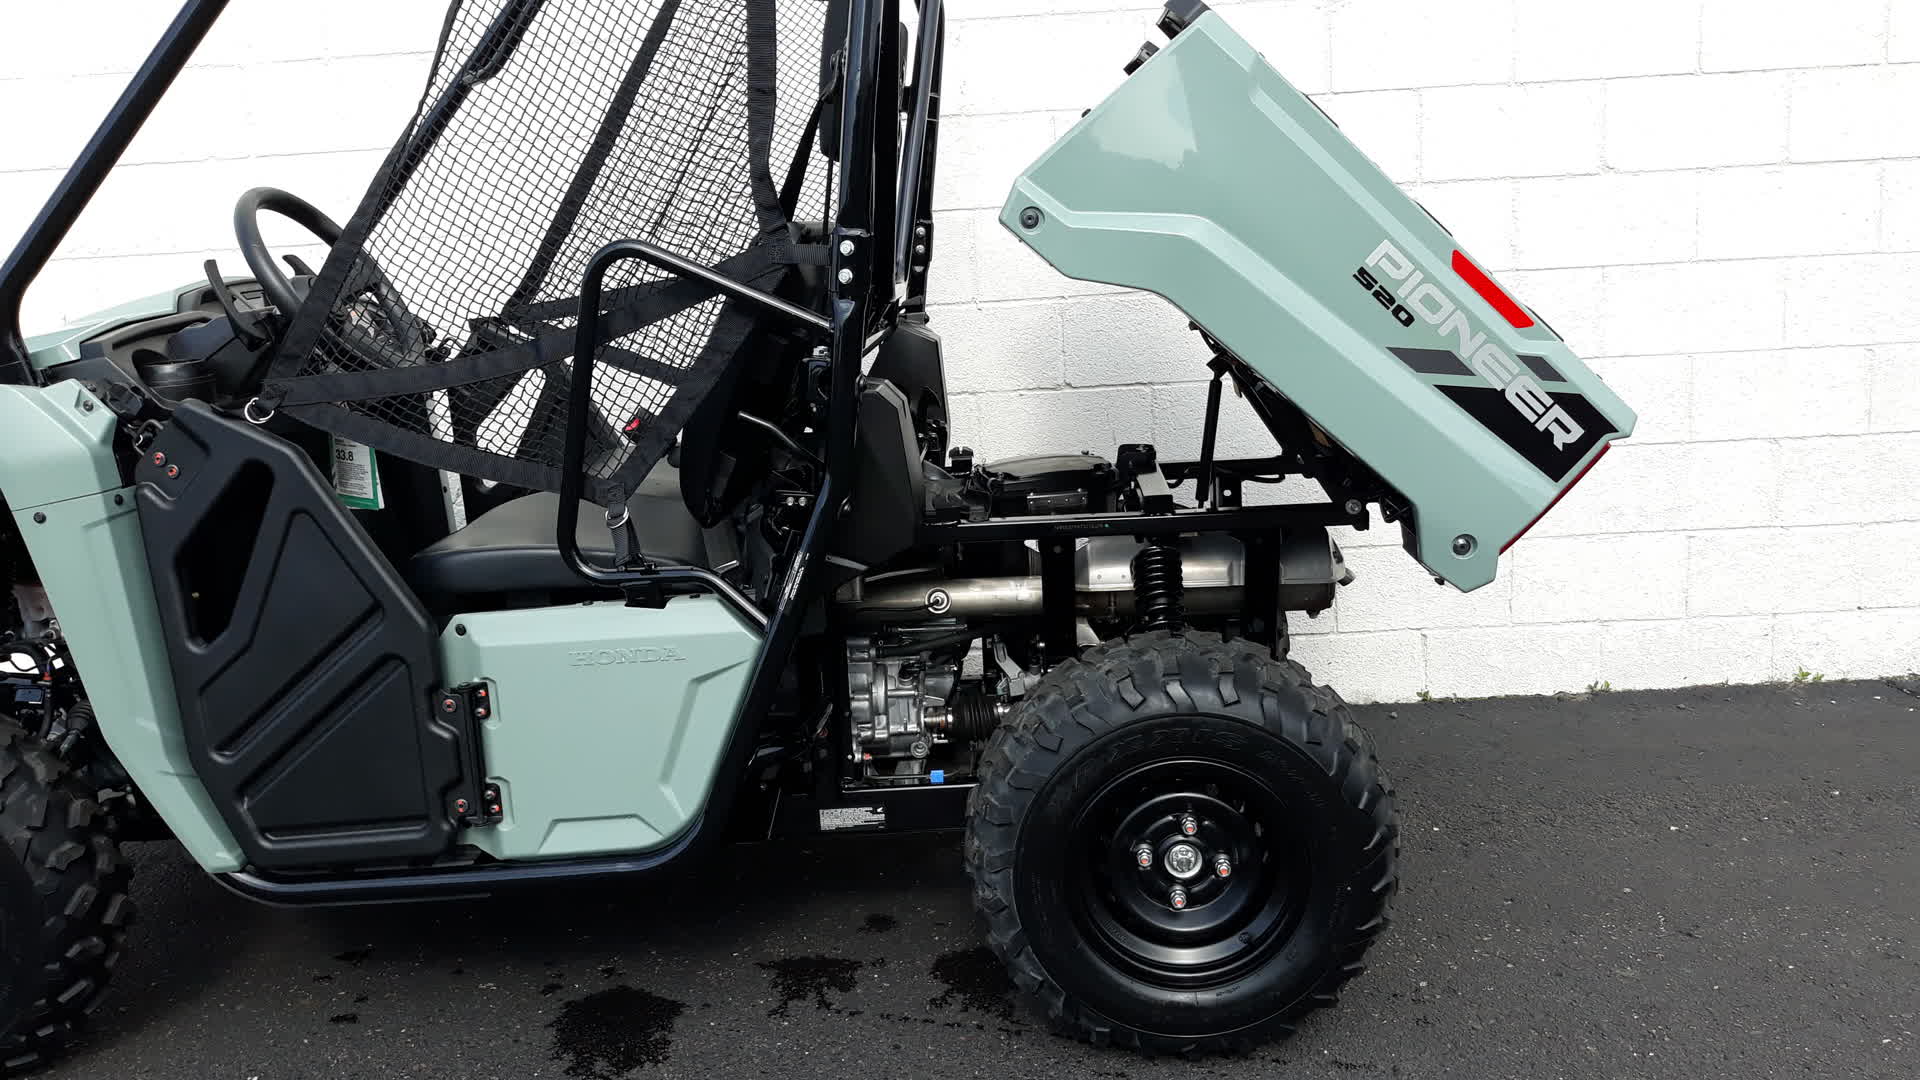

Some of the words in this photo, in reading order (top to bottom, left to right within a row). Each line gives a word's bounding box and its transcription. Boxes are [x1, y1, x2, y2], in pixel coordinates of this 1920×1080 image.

[1353, 267, 1415, 327] 520
[1365, 239, 1585, 451] PIONEER
[335, 449, 354, 461] 33.8
[568, 646, 686, 666] HONDA
